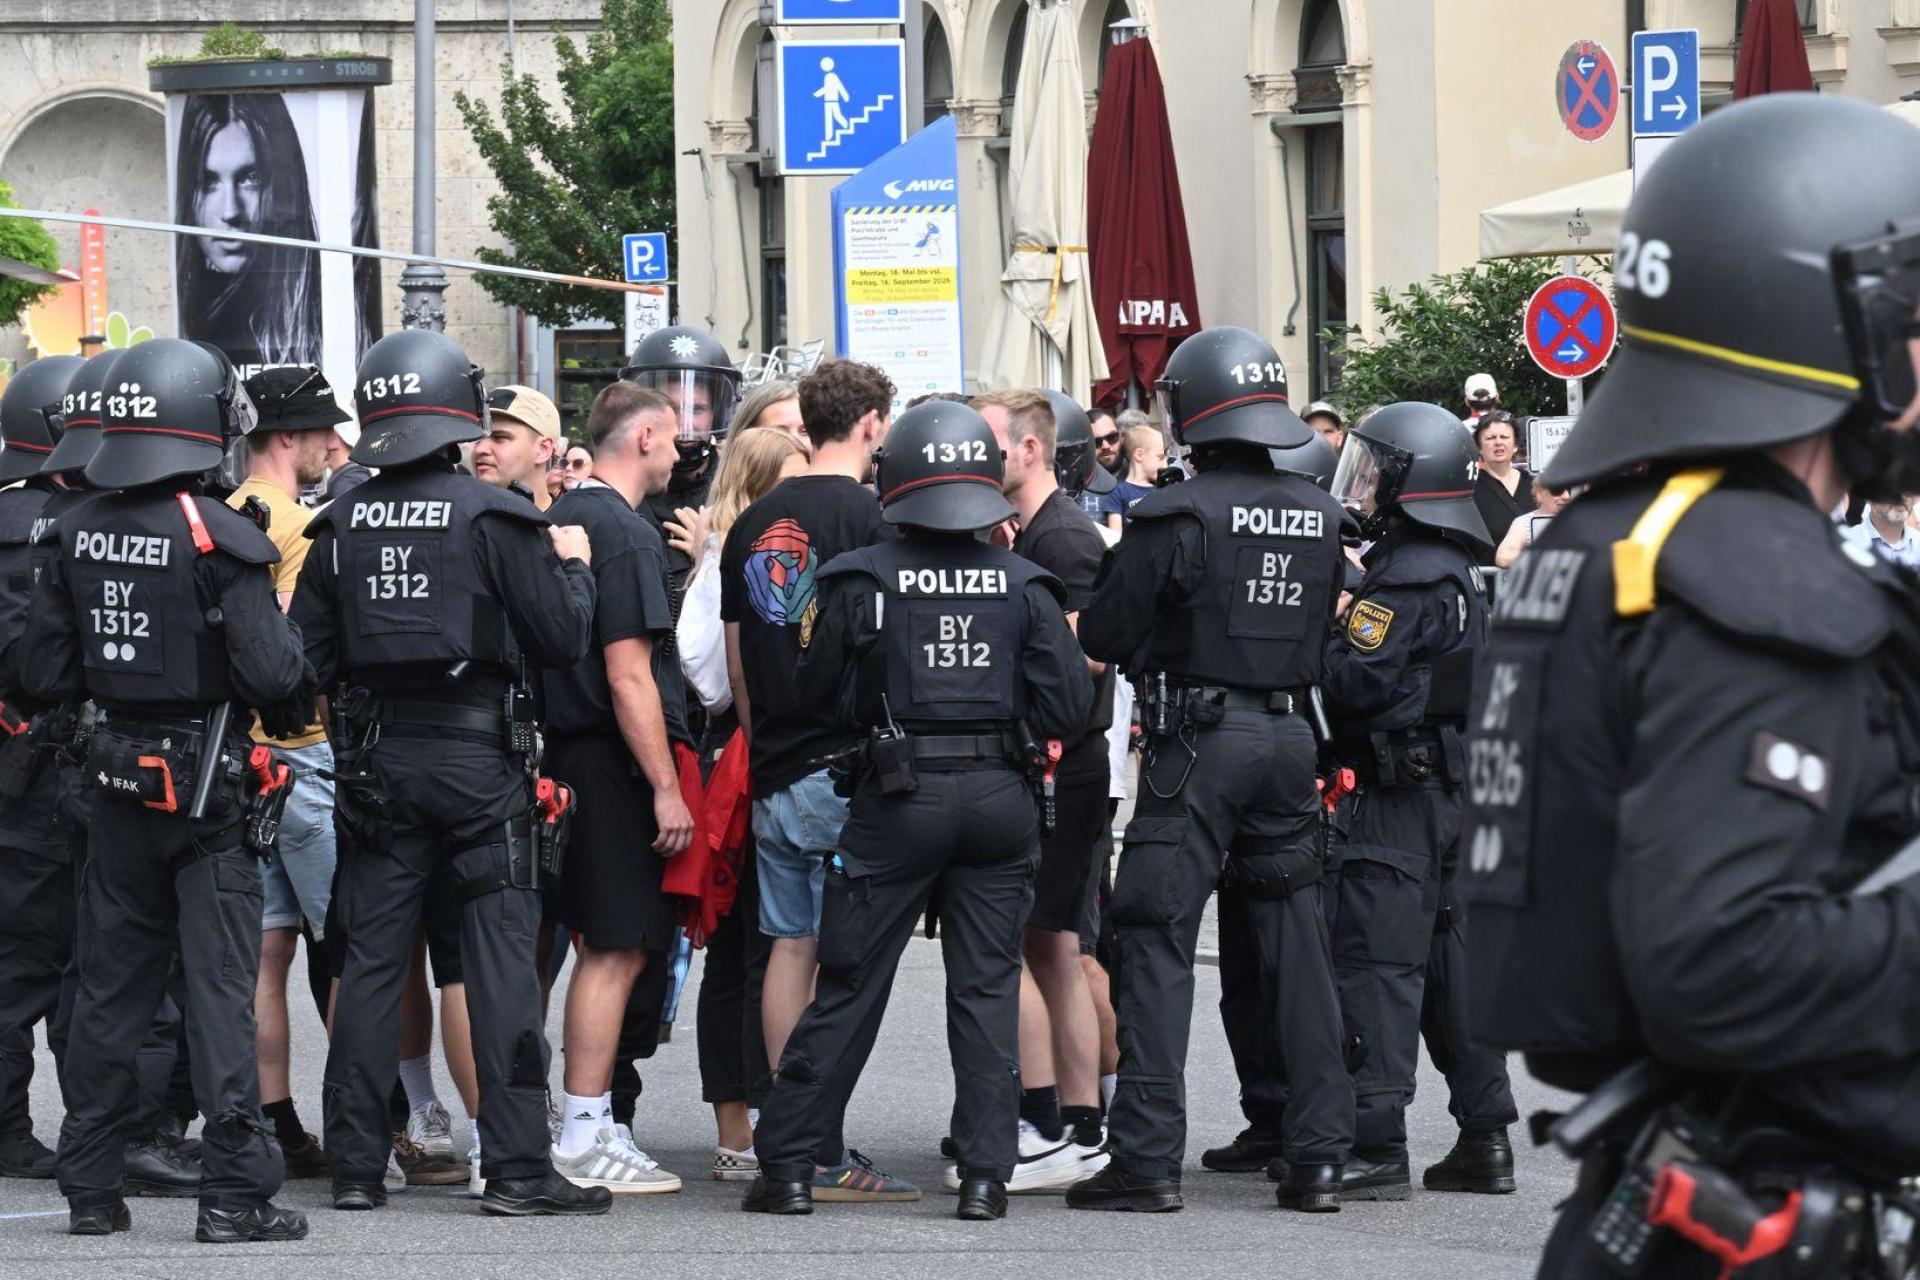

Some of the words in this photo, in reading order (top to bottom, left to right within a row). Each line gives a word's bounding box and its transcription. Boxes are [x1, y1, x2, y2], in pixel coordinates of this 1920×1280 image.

[1644, 45, 1678, 121] P
[905, 179, 954, 191] MVG
[631, 240, 655, 276] P
[893, 278, 930, 287] September
[1231, 362, 1286, 384] 1312
[363, 373, 421, 401] 1312
[107, 395, 157, 418] 1312
[922, 440, 988, 464] 1312
[351, 501, 452, 528] POLIZEI
[1232, 506, 1323, 537] POLIZEI
[75, 531, 170, 566] POLIZEI
[381, 546, 413, 571] BY
[1262, 552, 1292, 578] BY
[103, 580, 134, 607] BY
[367, 573, 429, 599] 1312
[898, 569, 1007, 594] POLIZEI
[1246, 579, 1303, 606] 1312
[90, 608, 150, 637] 1312
[1360, 604, 1389, 621] POLIZEI
[940, 615, 973, 641] BY
[923, 642, 991, 668] 1312
[112, 776, 139, 793] IFAK
